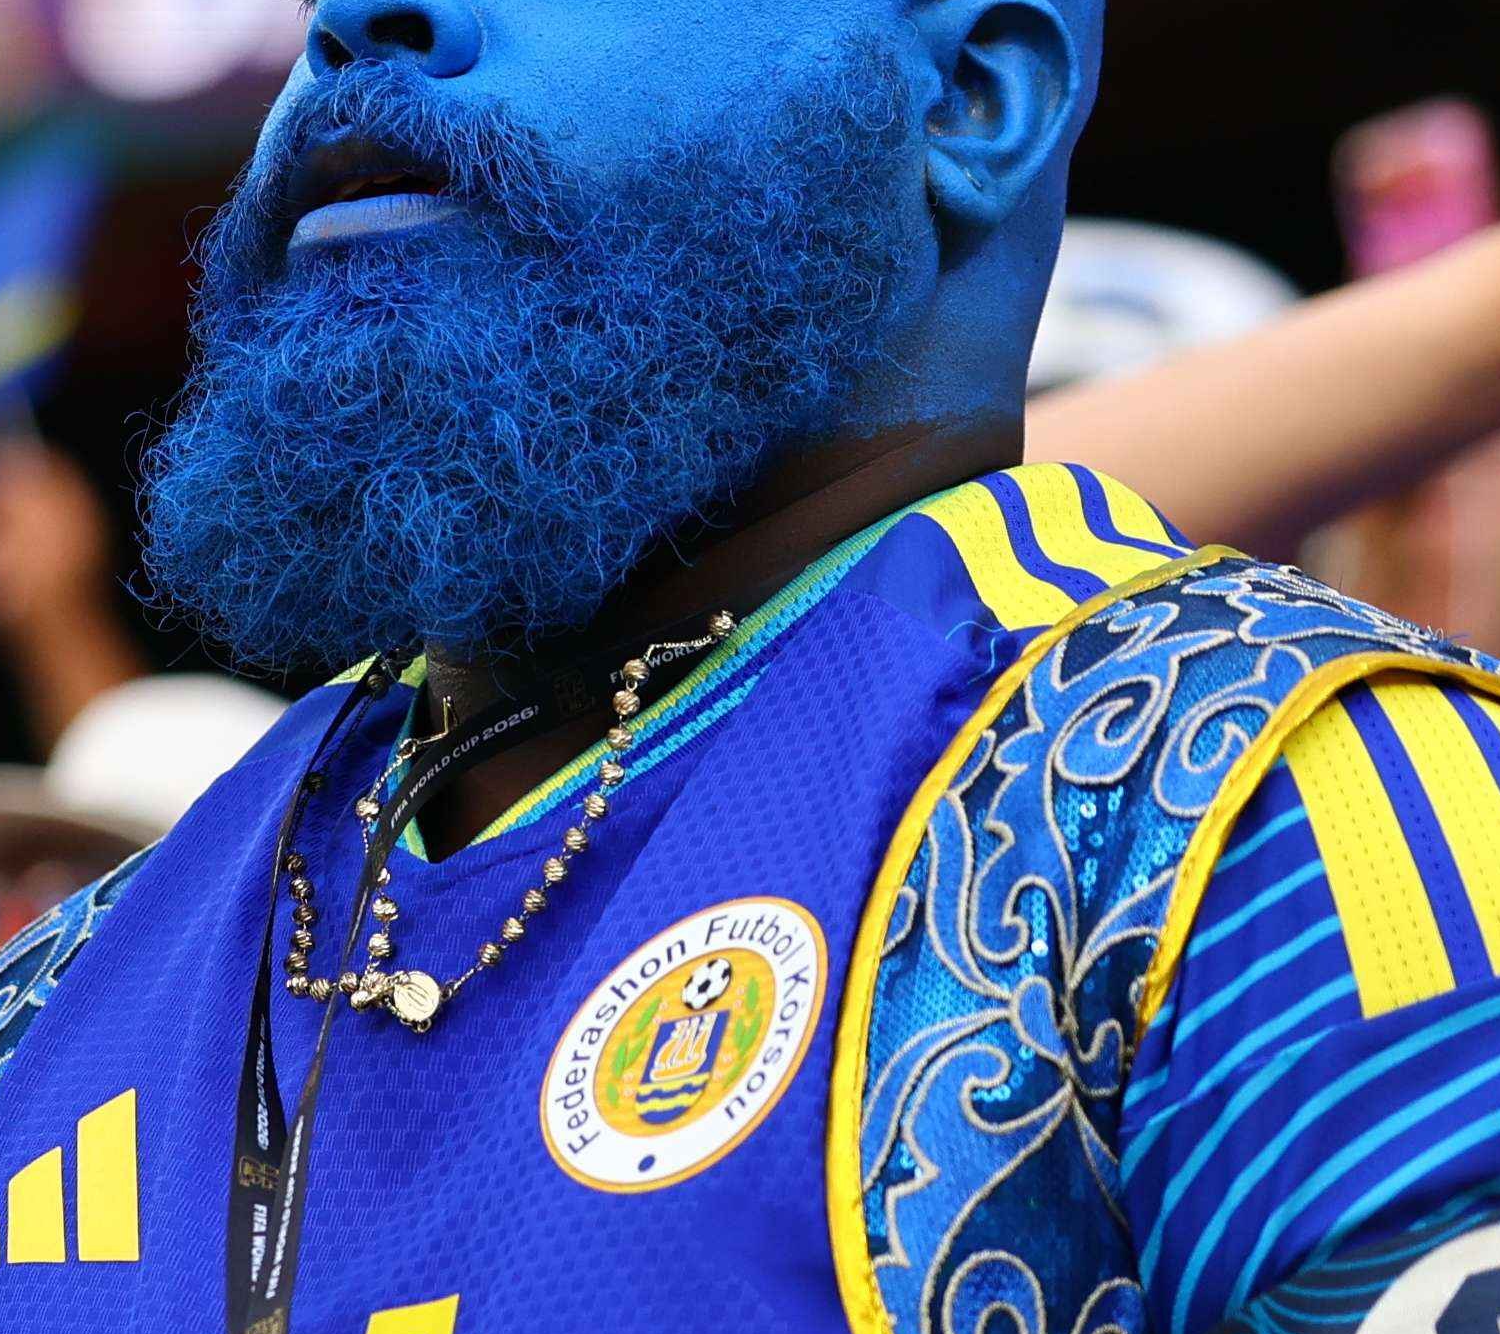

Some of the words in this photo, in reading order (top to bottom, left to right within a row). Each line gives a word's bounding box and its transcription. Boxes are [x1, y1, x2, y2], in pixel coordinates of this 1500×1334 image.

[409, 755, 451, 799] WORLD
[452, 735, 480, 759] CUP
[555, 938, 688, 1156] Federashon
